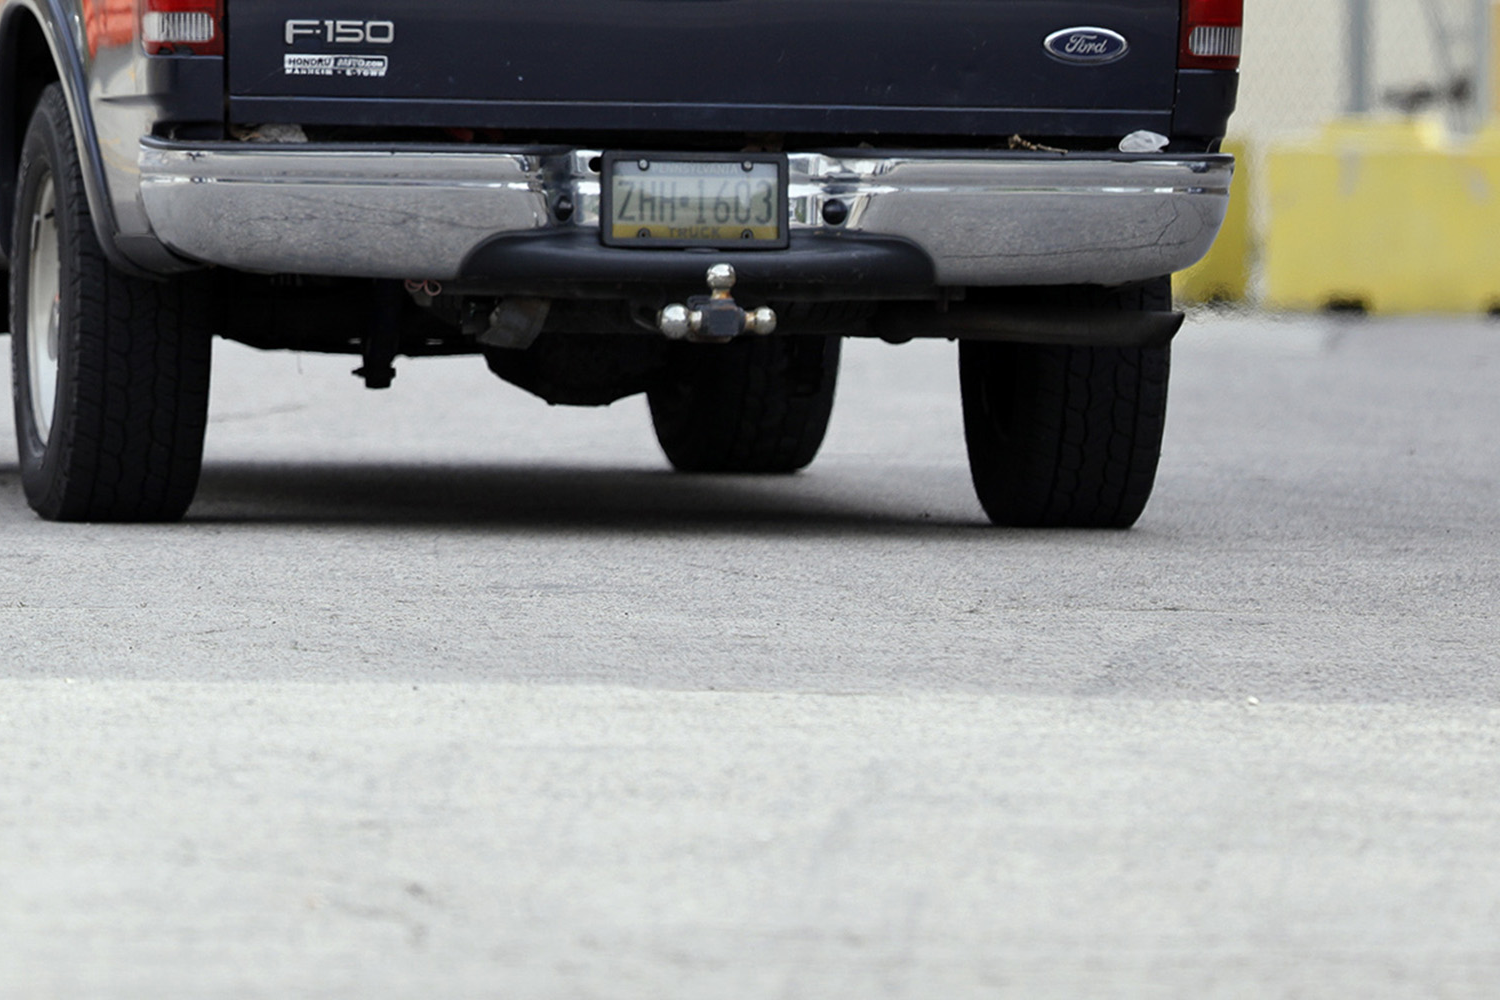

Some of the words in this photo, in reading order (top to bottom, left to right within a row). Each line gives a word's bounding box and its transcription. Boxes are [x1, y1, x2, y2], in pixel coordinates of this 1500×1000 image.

[285, 19, 395, 45] F-150
[1064, 33, 1108, 54] Ford
[651, 162, 739, 174] PENNSYLVANIA
[667, 225, 721, 239] TRUCK
